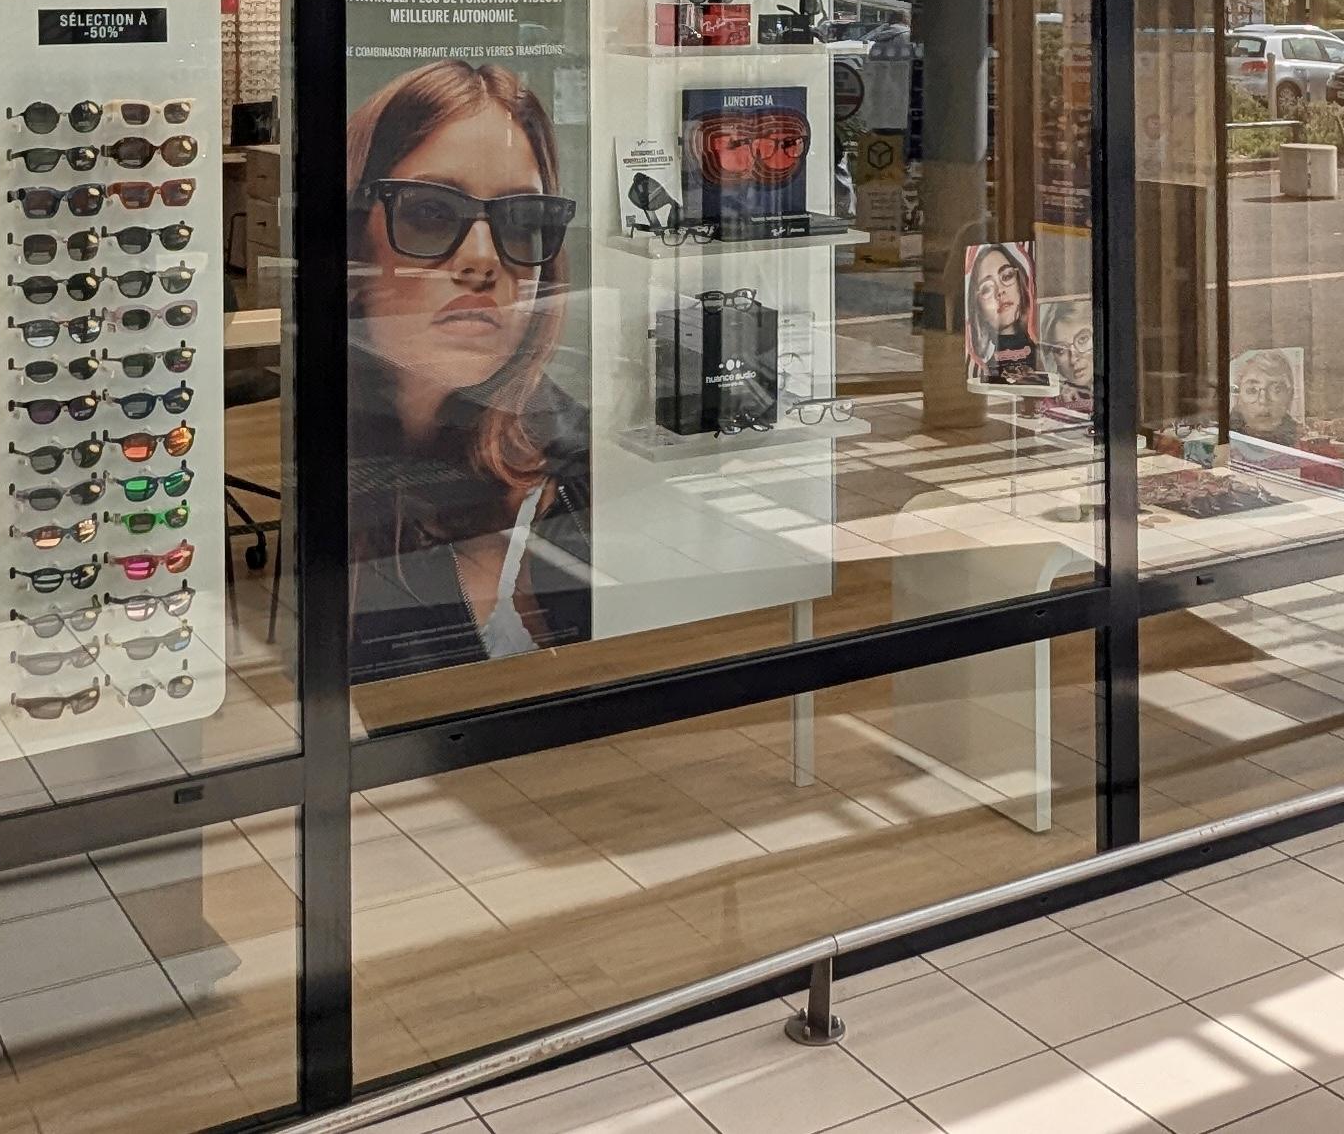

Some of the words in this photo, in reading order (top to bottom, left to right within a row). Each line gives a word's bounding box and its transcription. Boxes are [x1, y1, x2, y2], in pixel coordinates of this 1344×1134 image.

[59, 12, 134, 26] SÉLECTION
[138, 11, 148, 25] À
[390, 9, 450, 23] MEILLEURE
[452, 9, 518, 24] AUTONOMIE.
[723, 95, 764, 107] LUNETTES
